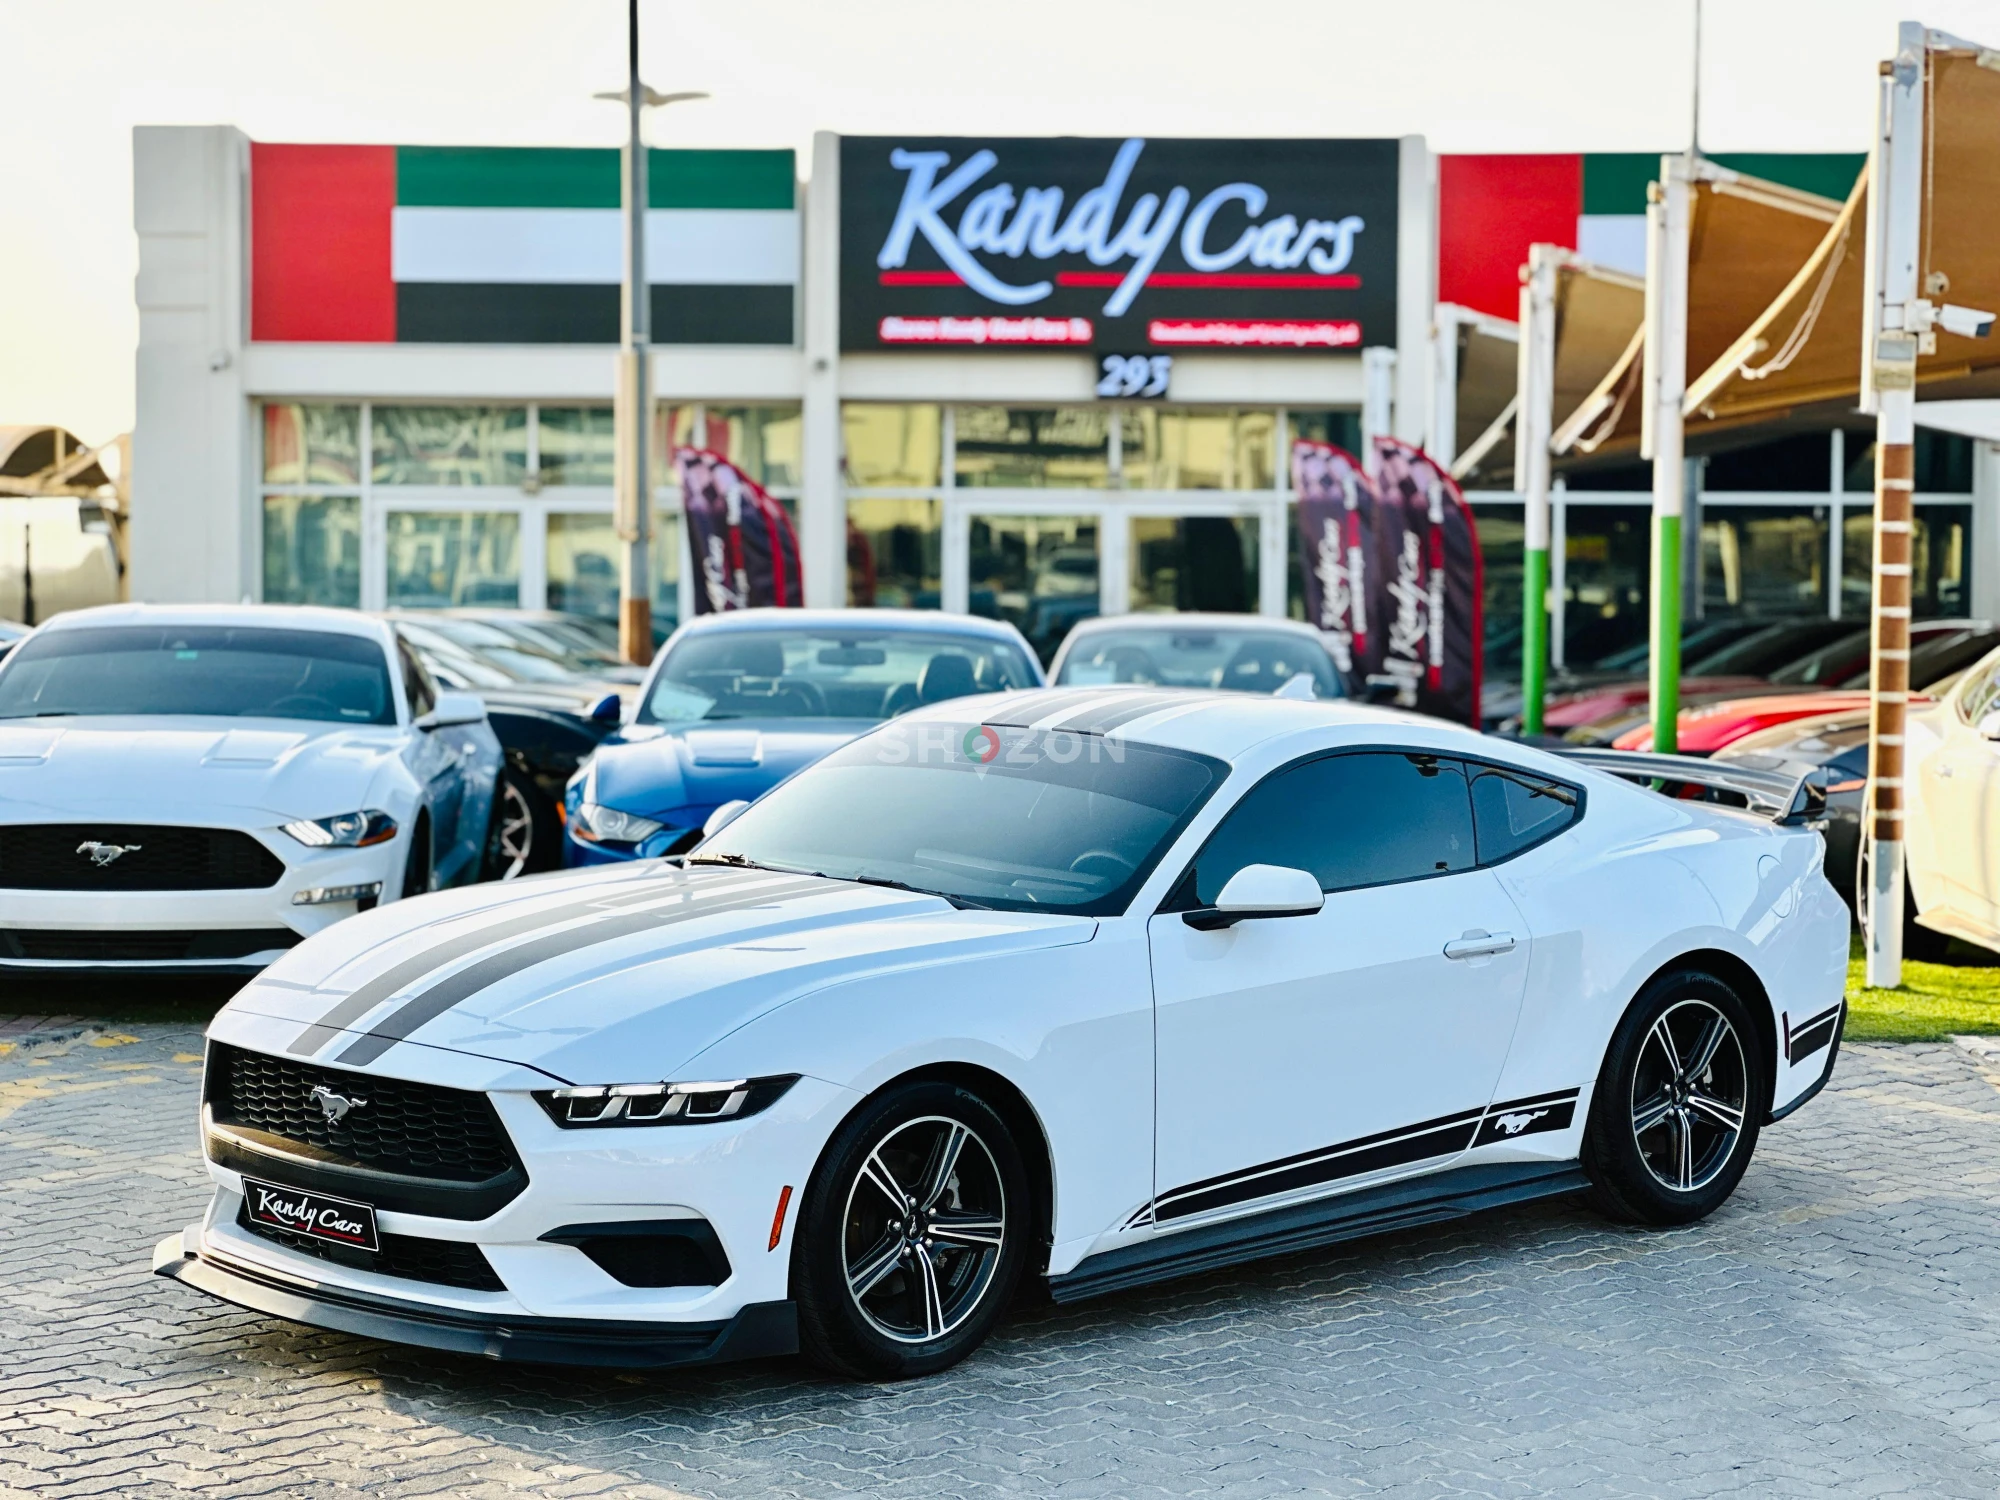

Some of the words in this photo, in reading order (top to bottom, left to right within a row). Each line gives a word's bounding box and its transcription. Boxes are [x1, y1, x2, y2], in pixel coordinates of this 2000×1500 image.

[878, 138, 1189, 317] Kandy
[1182, 182, 1365, 275] Cars
[1097, 355, 1172, 397] 295
[257, 1188, 317, 1231] Kandy
[319, 1209, 363, 1234] Cars
